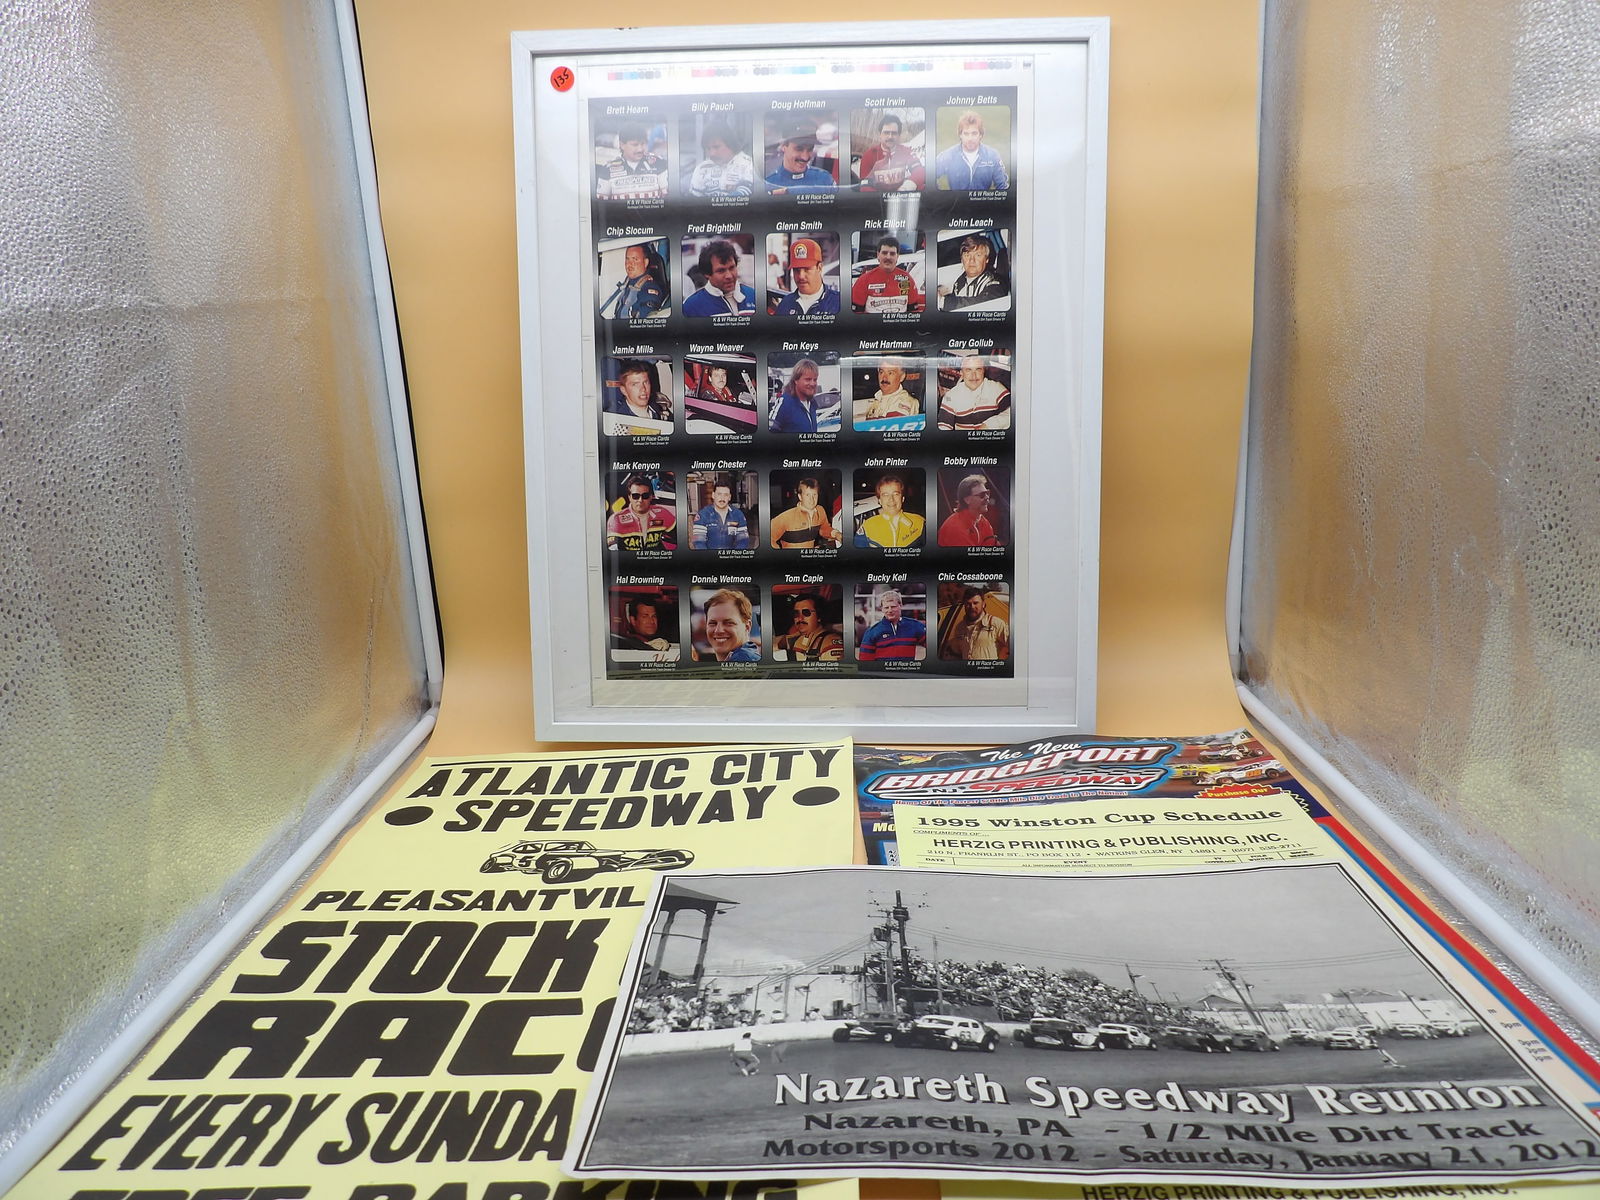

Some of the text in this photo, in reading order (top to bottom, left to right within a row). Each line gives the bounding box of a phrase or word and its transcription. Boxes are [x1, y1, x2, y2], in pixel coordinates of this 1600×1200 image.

[554, 68, 568, 87] 135
[772, 100, 826, 110] Doug Hoffman
[864, 98, 905, 106] Scott Irwin
[946, 95, 997, 106] Johnny Betts
[606, 105, 648, 114] Brett Hearn
[692, 102, 734, 112] Billy Pauch
[776, 221, 822, 230] Glenn Smith
[864, 220, 881, 228] Rick
[949, 218, 993, 227] John Leach
[606, 226, 653, 237] Chip Slocum
[688, 223, 741, 234] Fred Brightbill
[690, 343, 744, 353] Wayne Weaver
[783, 342, 818, 350] Ron Keys
[859, 340, 912, 348] Newt Hartman
[948, 339, 994, 349] Gary Gollub
[613, 345, 654, 354] Jamie Mills
[632, 462, 660, 470] Kenyon
[692, 460, 746, 470] Jimmy Chester
[783, 460, 799, 468] Sam
[864, 458, 908, 466] John Pinter
[944, 456, 998, 466] Bobby Wilkins
[630, 576, 664, 585] Browning
[692, 576, 718, 584] Donnie
[785, 574, 800, 582] Tom
[868, 574, 891, 582] Bucky
[938, 572, 1003, 581] Chic Cossaboone
[980, 742, 1081, 762] The New
[876, 746, 1170, 789] BRIDGEPORT
[406, 748, 841, 798] ATLANTIC CITY
[969, 775, 1152, 792] SPEEDWAY
[1207, 790, 1250, 798] Purchase
[443, 785, 776, 832] SPEEDWAY
[918, 810, 1282, 827] 1995 Winston Cup Schedule
[872, 822, 896, 832] Mo
[934, 834, 1288, 849] HERZIG PRINTING & PUBLISHING, INC.
[302, 886, 646, 912] PLEASANTVIL
[230, 918, 611, 994] STOCK
[148, 996, 616, 1080] RAC
[774, 1072, 1544, 1124] Nazareth Speedway Reunion
[58, 1088, 578, 1171] EVERY SUNDA
[804, 1112, 1002, 1136] Nazareth,
[1016, 1117, 1074, 1138] PA
[1140, 1122, 1210, 1142] 1/2
[1225, 1124, 1319, 1143] Mile
[1328, 1122, 1408, 1142] Dirt
[1417, 1119, 1544, 1140] Track
[763, 1138, 980, 1160] Motorsports
[992, 1142, 1080, 1162] 2012
[1118, 1145, 1288, 1169] Saturday,
[1294, 1148, 1432, 1171] January
[1440, 1145, 1505, 1167] 21,
[1509, 1140, 1600, 1163] 2012
[1081, 1186, 1168, 1200] HERZIG
[1172, 1185, 1284, 1200] PRINTING
[1291, 1188, 1305, 1199] &
